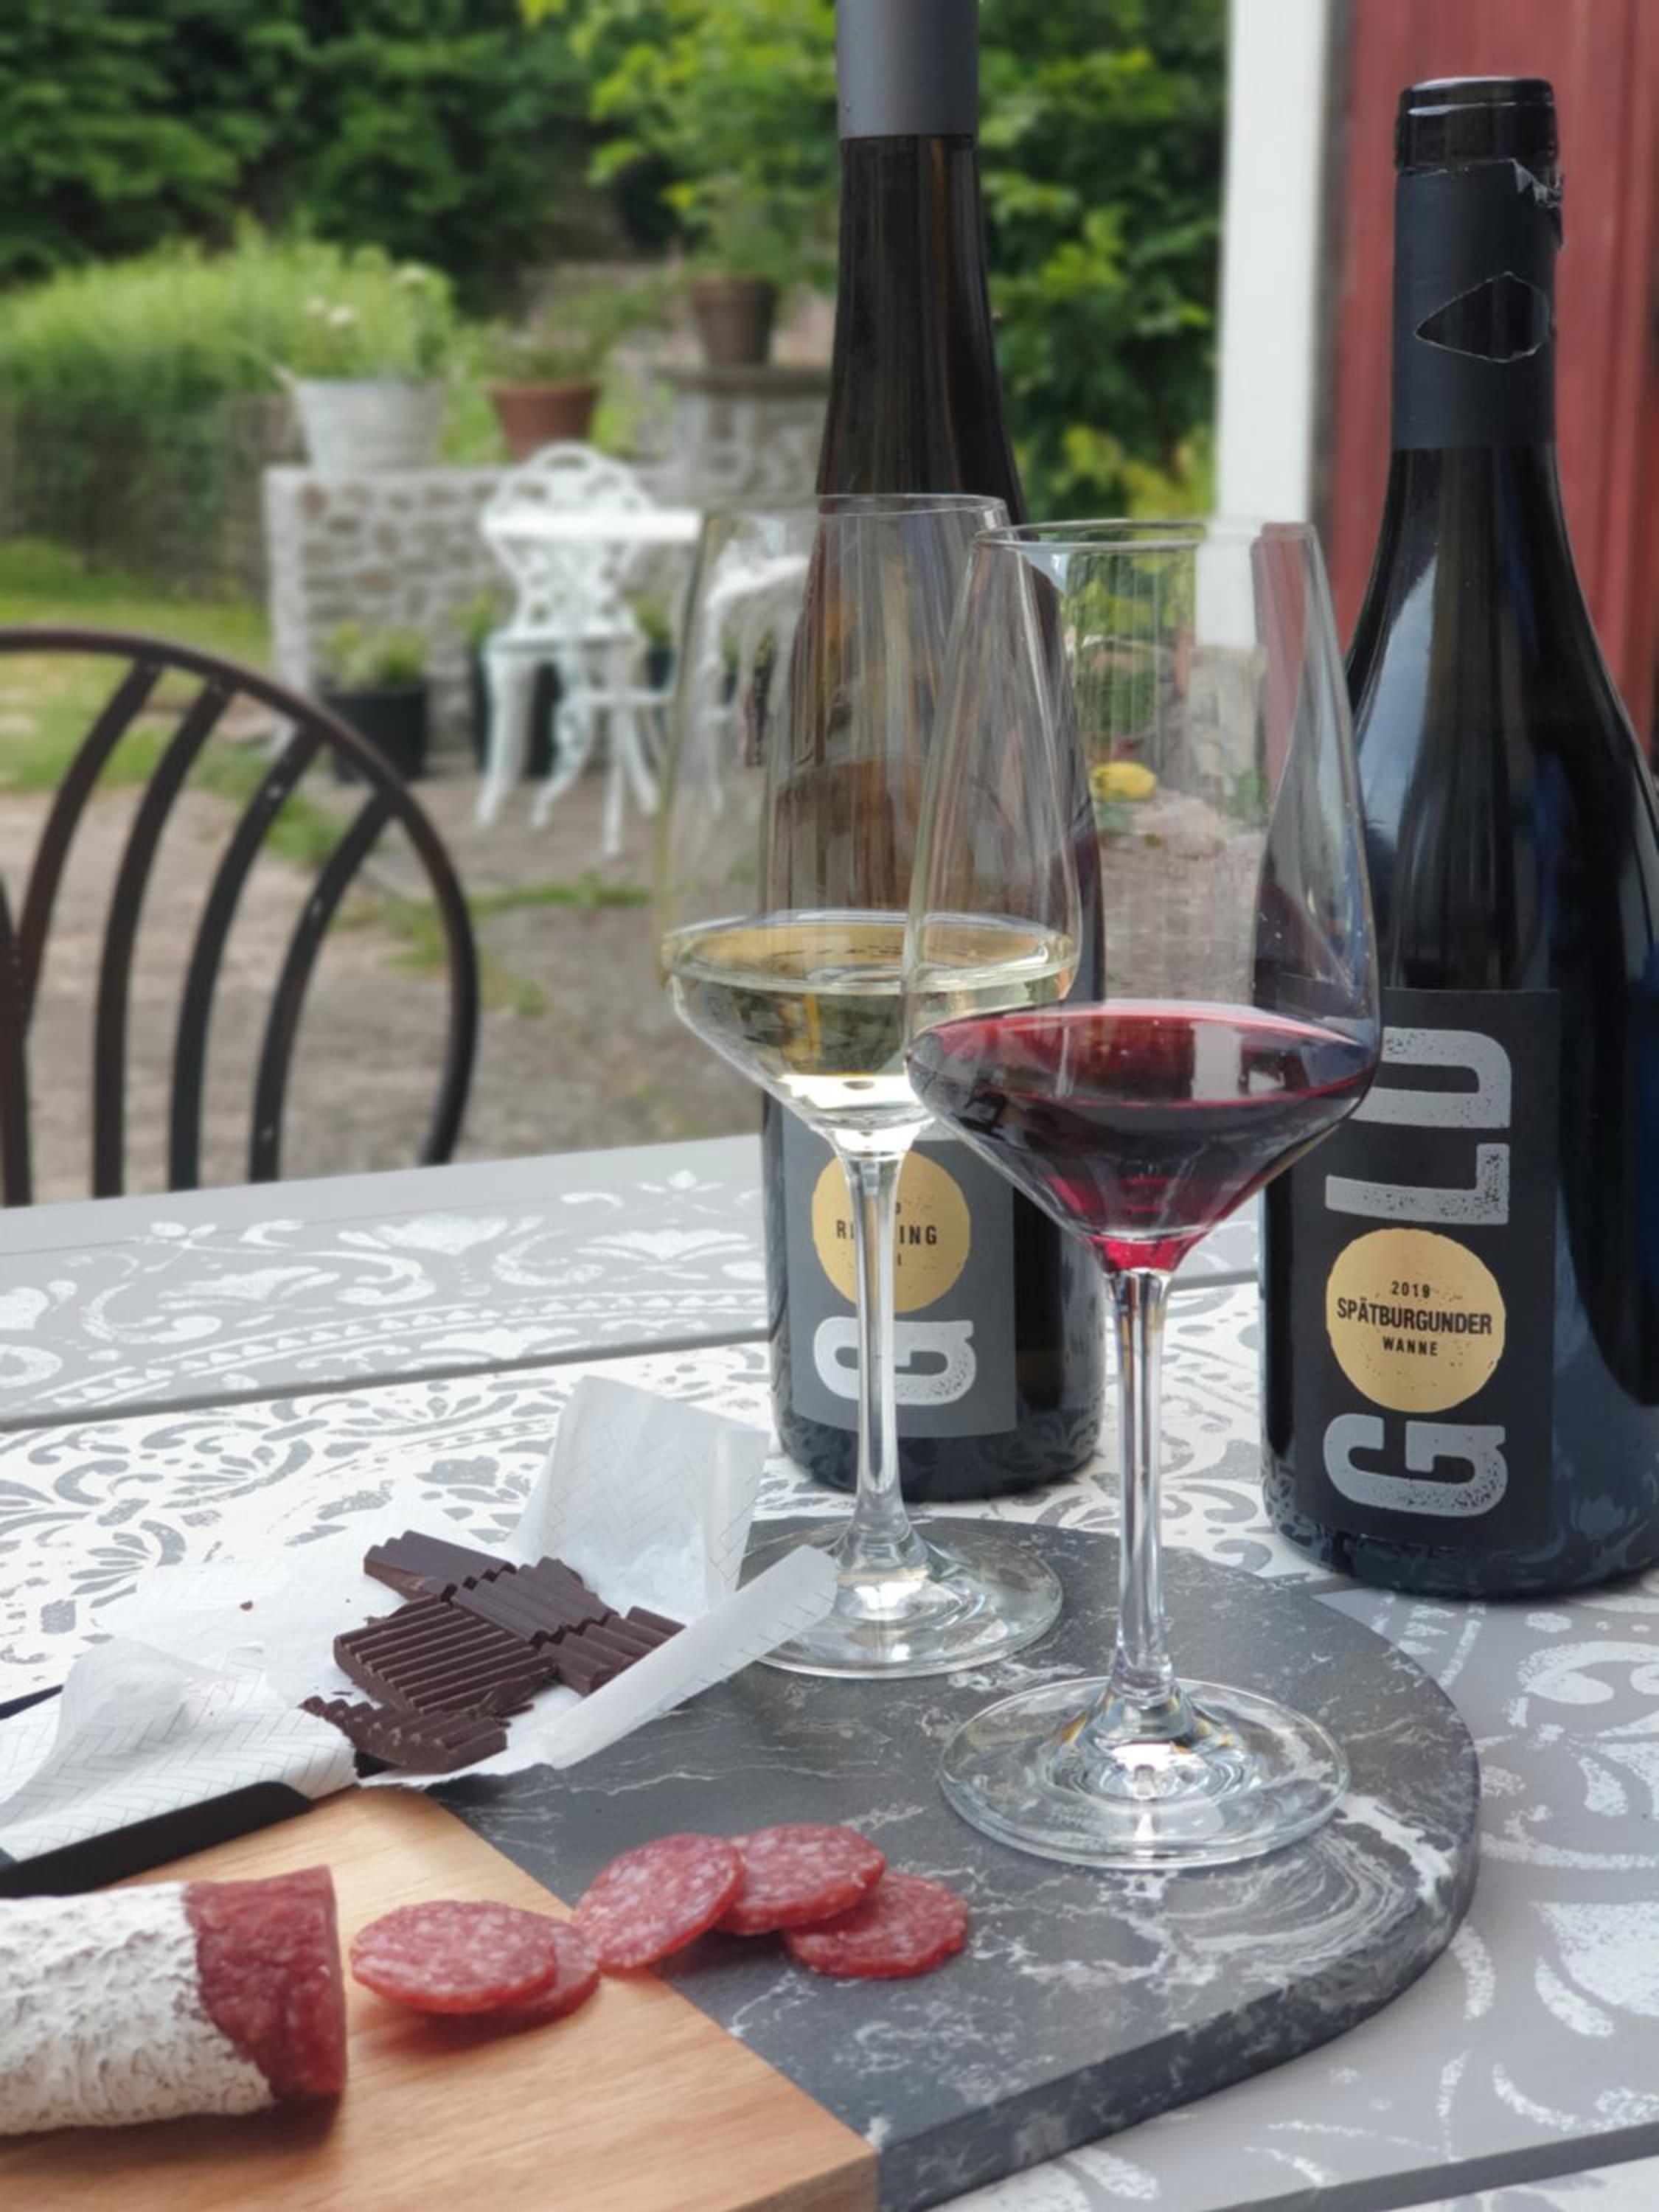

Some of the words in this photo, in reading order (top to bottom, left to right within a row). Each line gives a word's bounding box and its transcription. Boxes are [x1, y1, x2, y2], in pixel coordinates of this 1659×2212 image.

[836, 1220, 938, 1245] RIING
[1391, 1281, 1430, 1298] 2019
[1337, 1297, 1492, 1335] SPÄTBURGUNDER
[1382, 1336, 1438, 1356] WANNE
